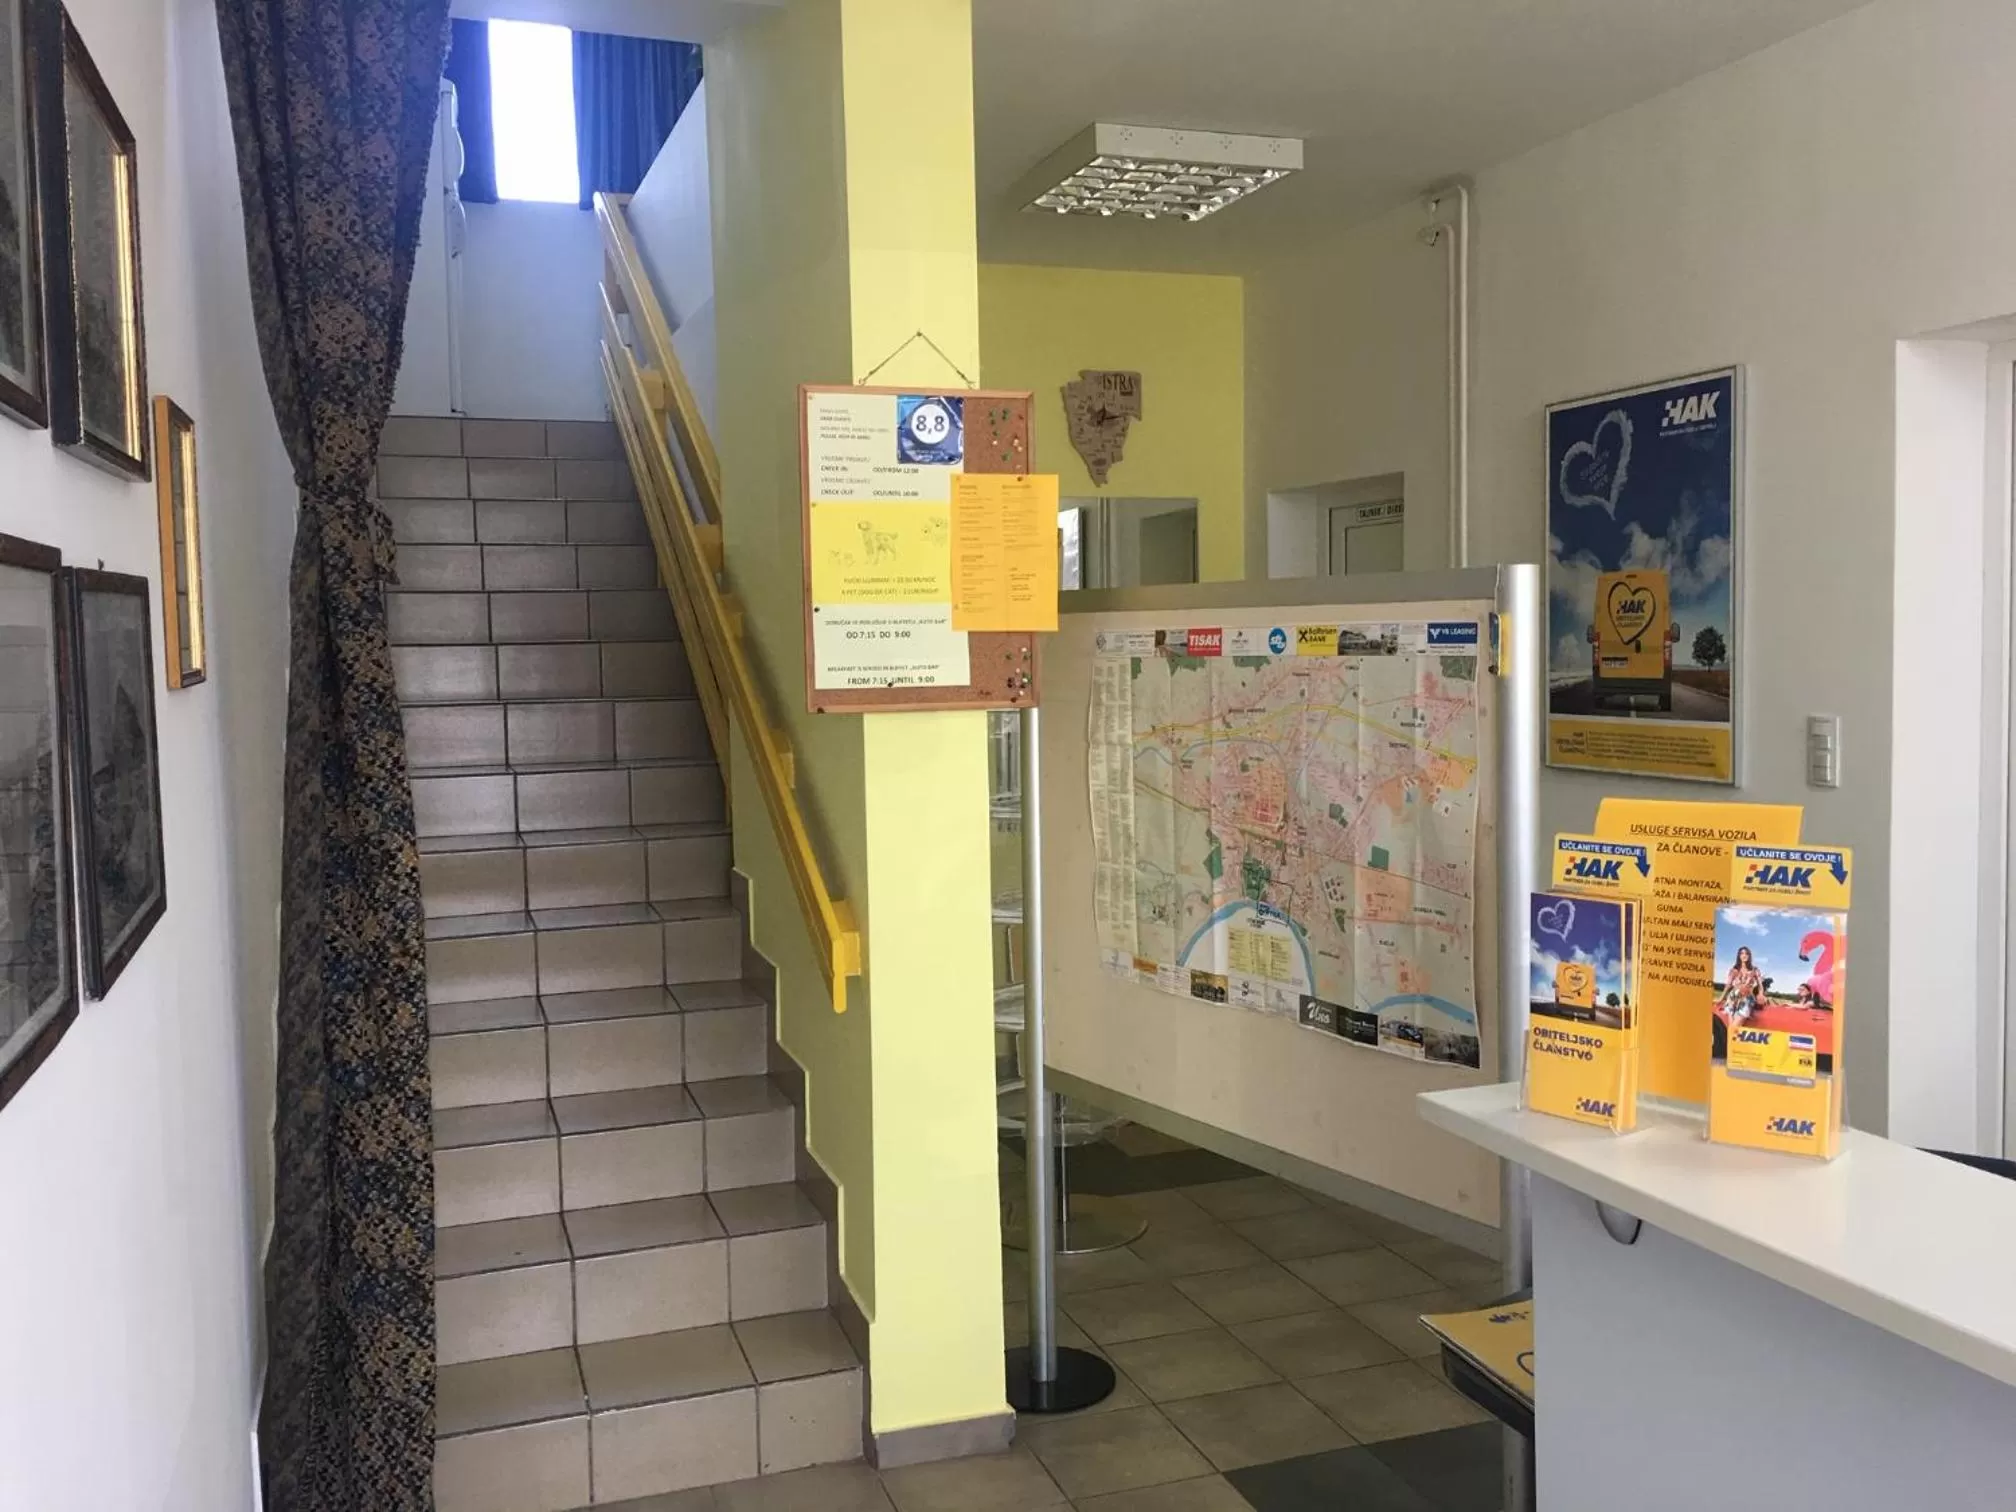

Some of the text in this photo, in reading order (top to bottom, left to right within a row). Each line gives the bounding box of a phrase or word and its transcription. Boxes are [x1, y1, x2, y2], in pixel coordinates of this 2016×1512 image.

[1103, 374, 1134, 391] ISTRA
[1661, 391, 1720, 427] HAK
[916, 414, 945, 434] 8,8
[846, 631, 858, 639] OD
[879, 631, 891, 639] DO
[1189, 634, 1221, 647] TISAK
[847, 676, 870, 685] FROM
[1630, 823, 1757, 841] USLUGE SERVISA VOZILA
[1602, 844, 1613, 853] SE
[1656, 842, 1670, 852] ZA
[1672, 841, 1722, 857] ČLANOVE
[1740, 848, 1787, 860] UČLANITE
[1789, 851, 1801, 860] SE
[1565, 855, 1624, 881] HAK
[1745, 863, 1816, 889] HAK
[1656, 903, 1684, 913] GUMA
[1671, 918, 1693, 929] MALI
[1652, 944, 1665, 953] NA
[1667, 946, 1683, 955] SVE
[1675, 960, 1706, 973] VOZILA
[1648, 971, 1661, 981] NA
[1533, 1026, 1604, 1049] OBITELJSKO
[1732, 1030, 1772, 1046] HAK
[1533, 1038, 1594, 1061] ČLANSTVO
[1576, 1097, 1617, 1118] HAK
[1766, 1116, 1817, 1137] HAK
